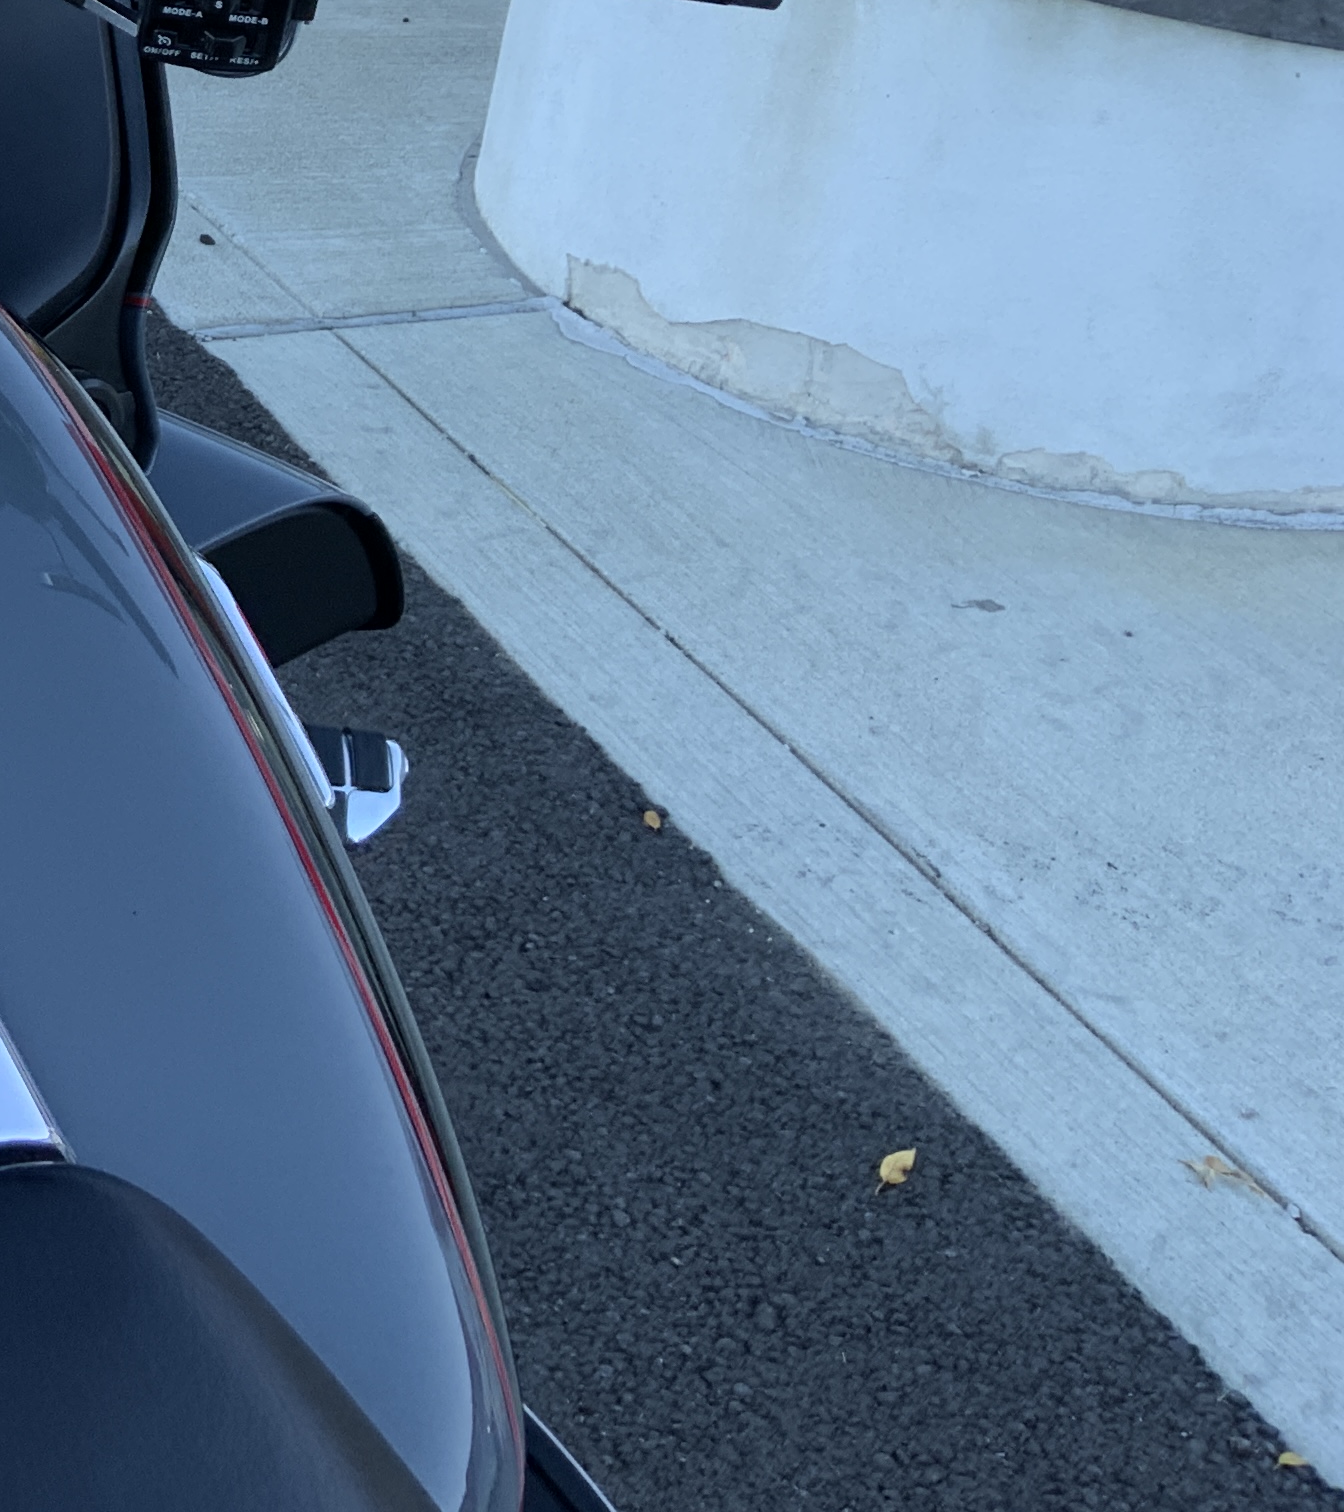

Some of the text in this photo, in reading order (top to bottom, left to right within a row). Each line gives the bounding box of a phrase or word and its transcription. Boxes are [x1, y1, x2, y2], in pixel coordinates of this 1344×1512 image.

[162, 5, 204, 19] MODE-A
[228, 13, 269, 25] MODE-B
[143, 45, 182, 57] ON/OFF
